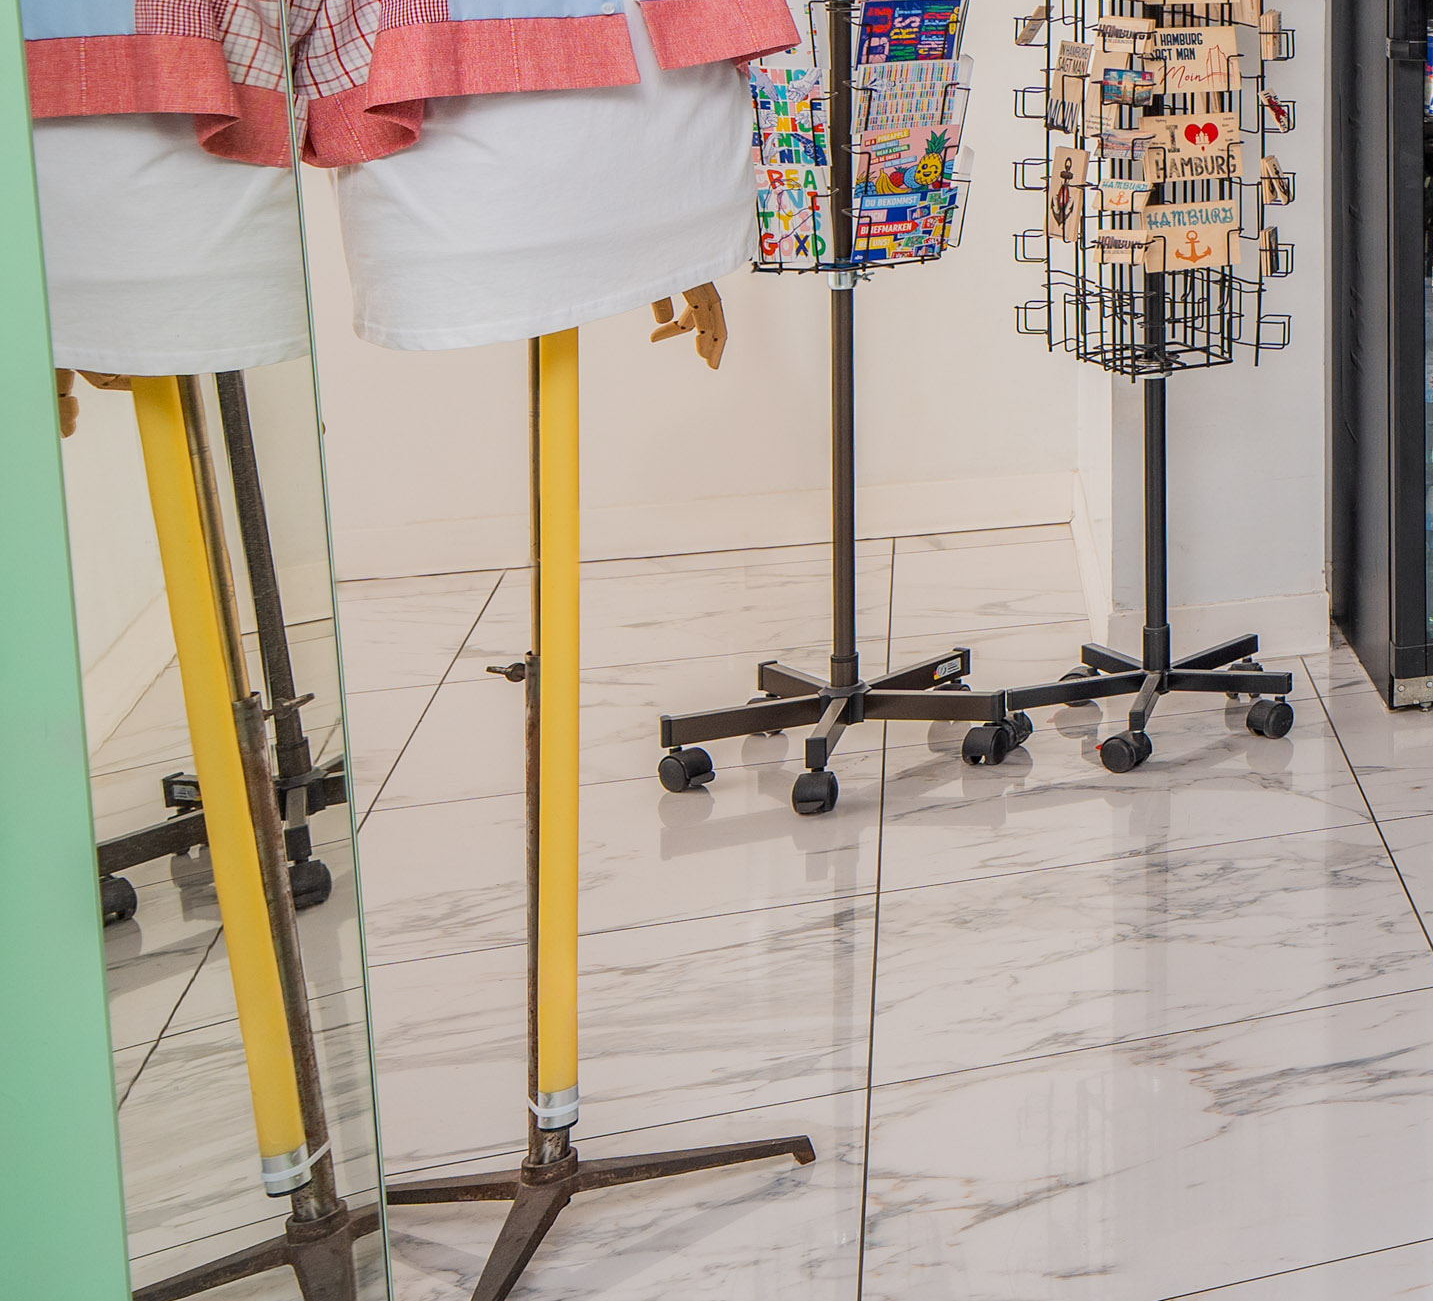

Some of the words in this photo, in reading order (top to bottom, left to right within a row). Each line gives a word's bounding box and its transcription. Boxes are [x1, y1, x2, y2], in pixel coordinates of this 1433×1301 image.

[1159, 32, 1203, 47] HAMBURG
[1175, 47, 1196, 61] MAN
[1158, 65, 1209, 89] Moin
[1165, 124, 1181, 154] I
[1156, 154, 1237, 180] HAMBURG
[865, 198, 875, 207] DU
[877, 196, 917, 206] BEKOMMST
[1146, 205, 1235, 230] HAMBURG
[860, 223, 912, 235] BRIEFMARKEN
